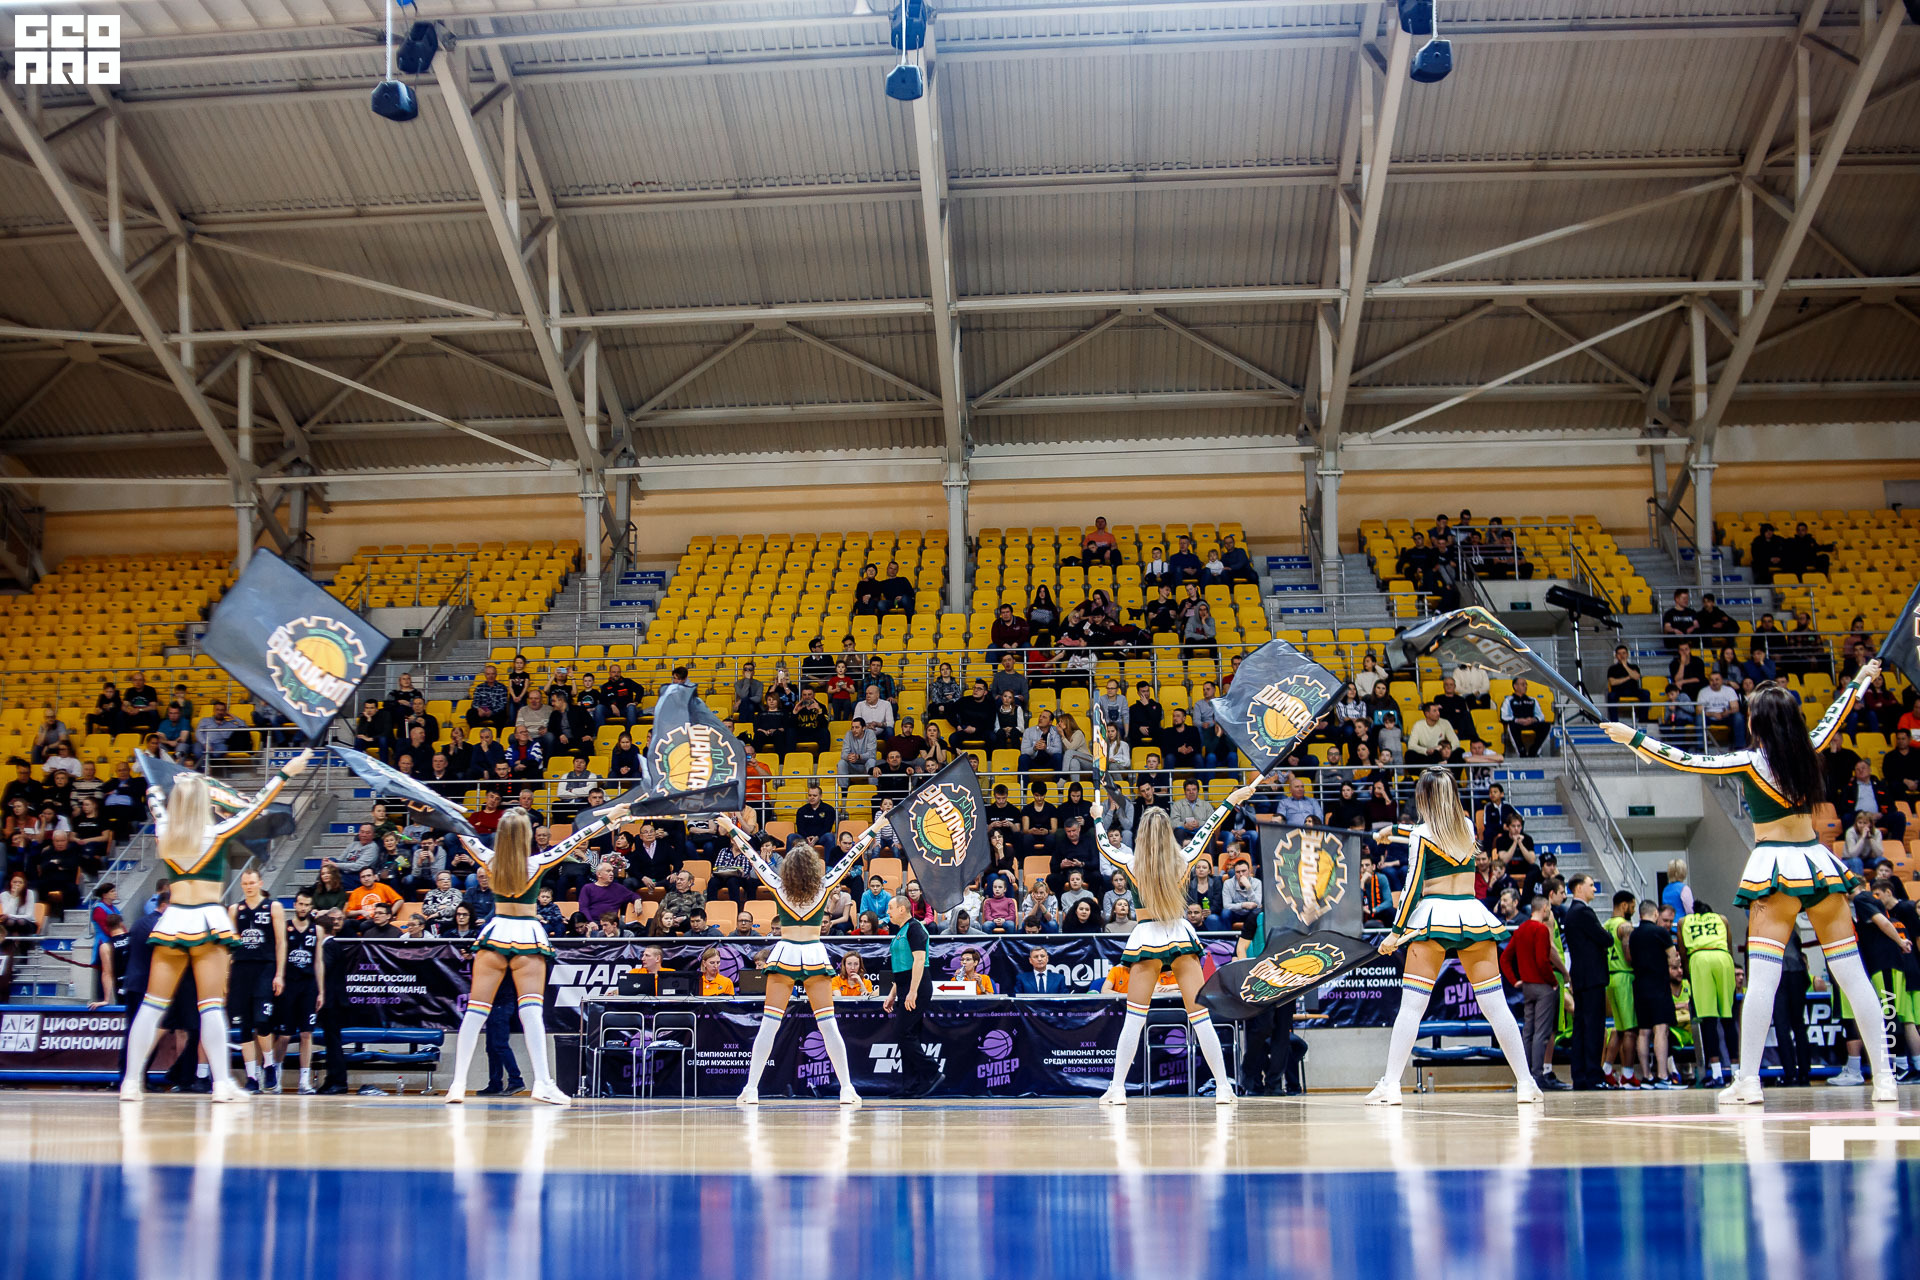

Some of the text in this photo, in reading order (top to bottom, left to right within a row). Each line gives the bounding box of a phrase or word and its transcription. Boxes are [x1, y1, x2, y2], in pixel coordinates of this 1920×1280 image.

[917, 784, 967, 867] УРАЛМАШ
[254, 912, 271, 924] 35
[1046, 959, 1115, 987] molt
[1355, 967, 1397, 976] РОССИИ
[378, 974, 417, 982] РОССИИ
[387, 986, 427, 994] КОМАНД
[1344, 990, 1382, 999] 2019/20
[977, 1057, 1020, 1079] СУПЕР
[986, 1074, 1011, 1088] ЛИГА
